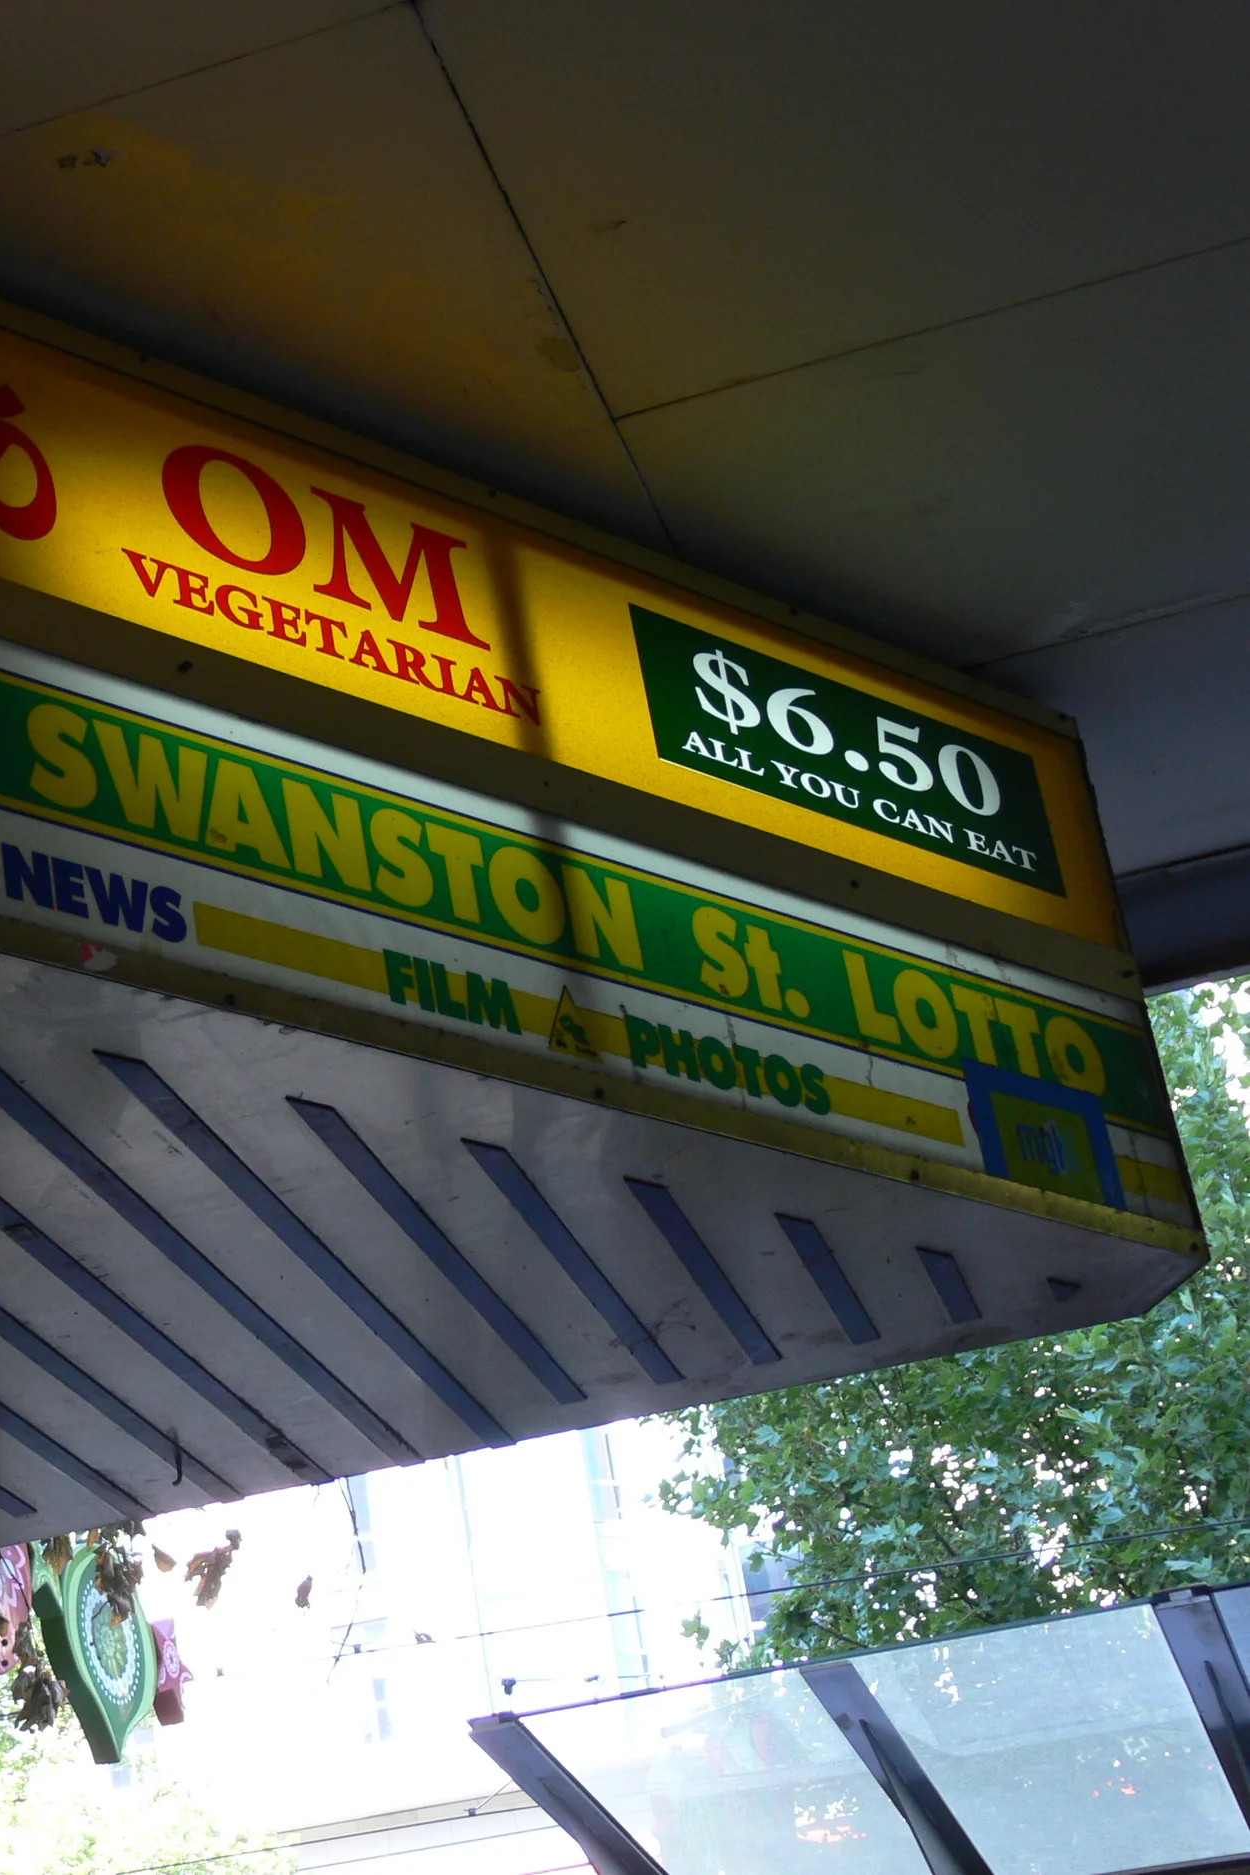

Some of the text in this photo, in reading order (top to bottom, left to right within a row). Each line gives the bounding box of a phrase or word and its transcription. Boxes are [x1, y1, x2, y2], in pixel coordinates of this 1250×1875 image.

[162, 445, 491, 651] OM
[121, 548, 540, 726] VEGETARIAN
[682, 731, 1037, 872] ALL YOU CAN EAT
[692, 649, 1002, 817] $6.50
[1, 843, 188, 943] NEWS
[26, 703, 1107, 1098] SWANSTON St. LOTTO
[381, 949, 832, 1116] FILM PHOTOS
